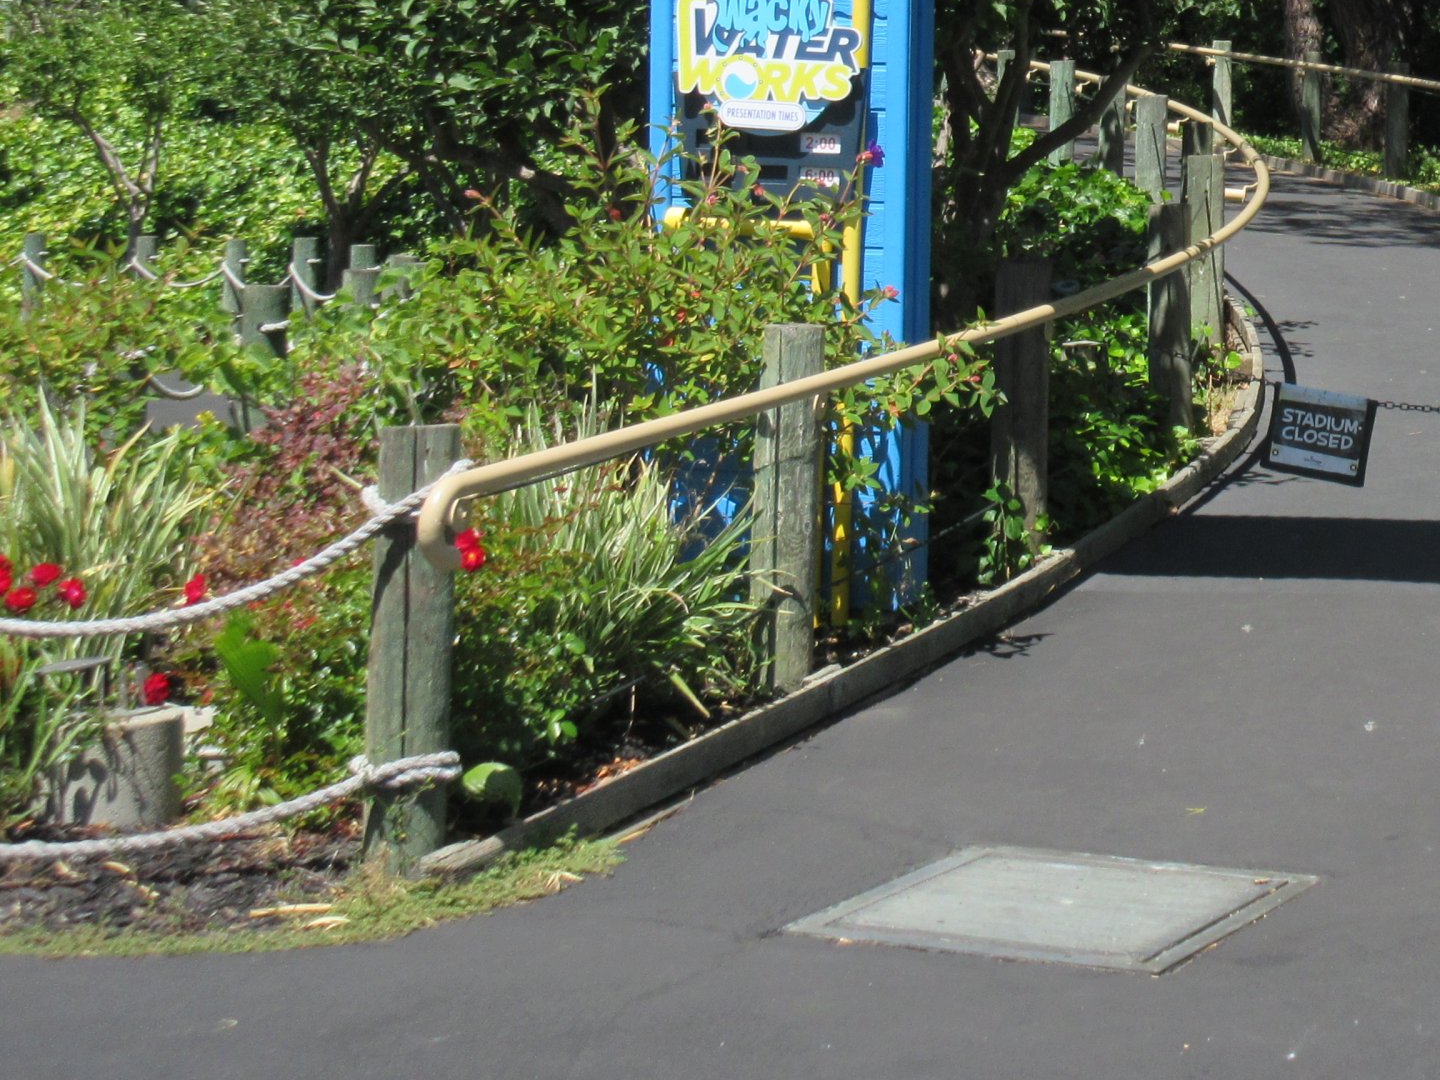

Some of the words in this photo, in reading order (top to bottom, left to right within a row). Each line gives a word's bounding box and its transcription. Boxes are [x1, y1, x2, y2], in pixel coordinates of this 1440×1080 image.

[695, 7, 861, 73] WATER
[726, 107, 776, 120] PRESENTATION
[778, 111, 799, 122] TIMES
[805, 136, 836, 150] 2:00
[804, 169, 835, 183] 6:00
[1282, 408, 1358, 434] STADIUM
[1281, 426, 1354, 450] CLOSED
